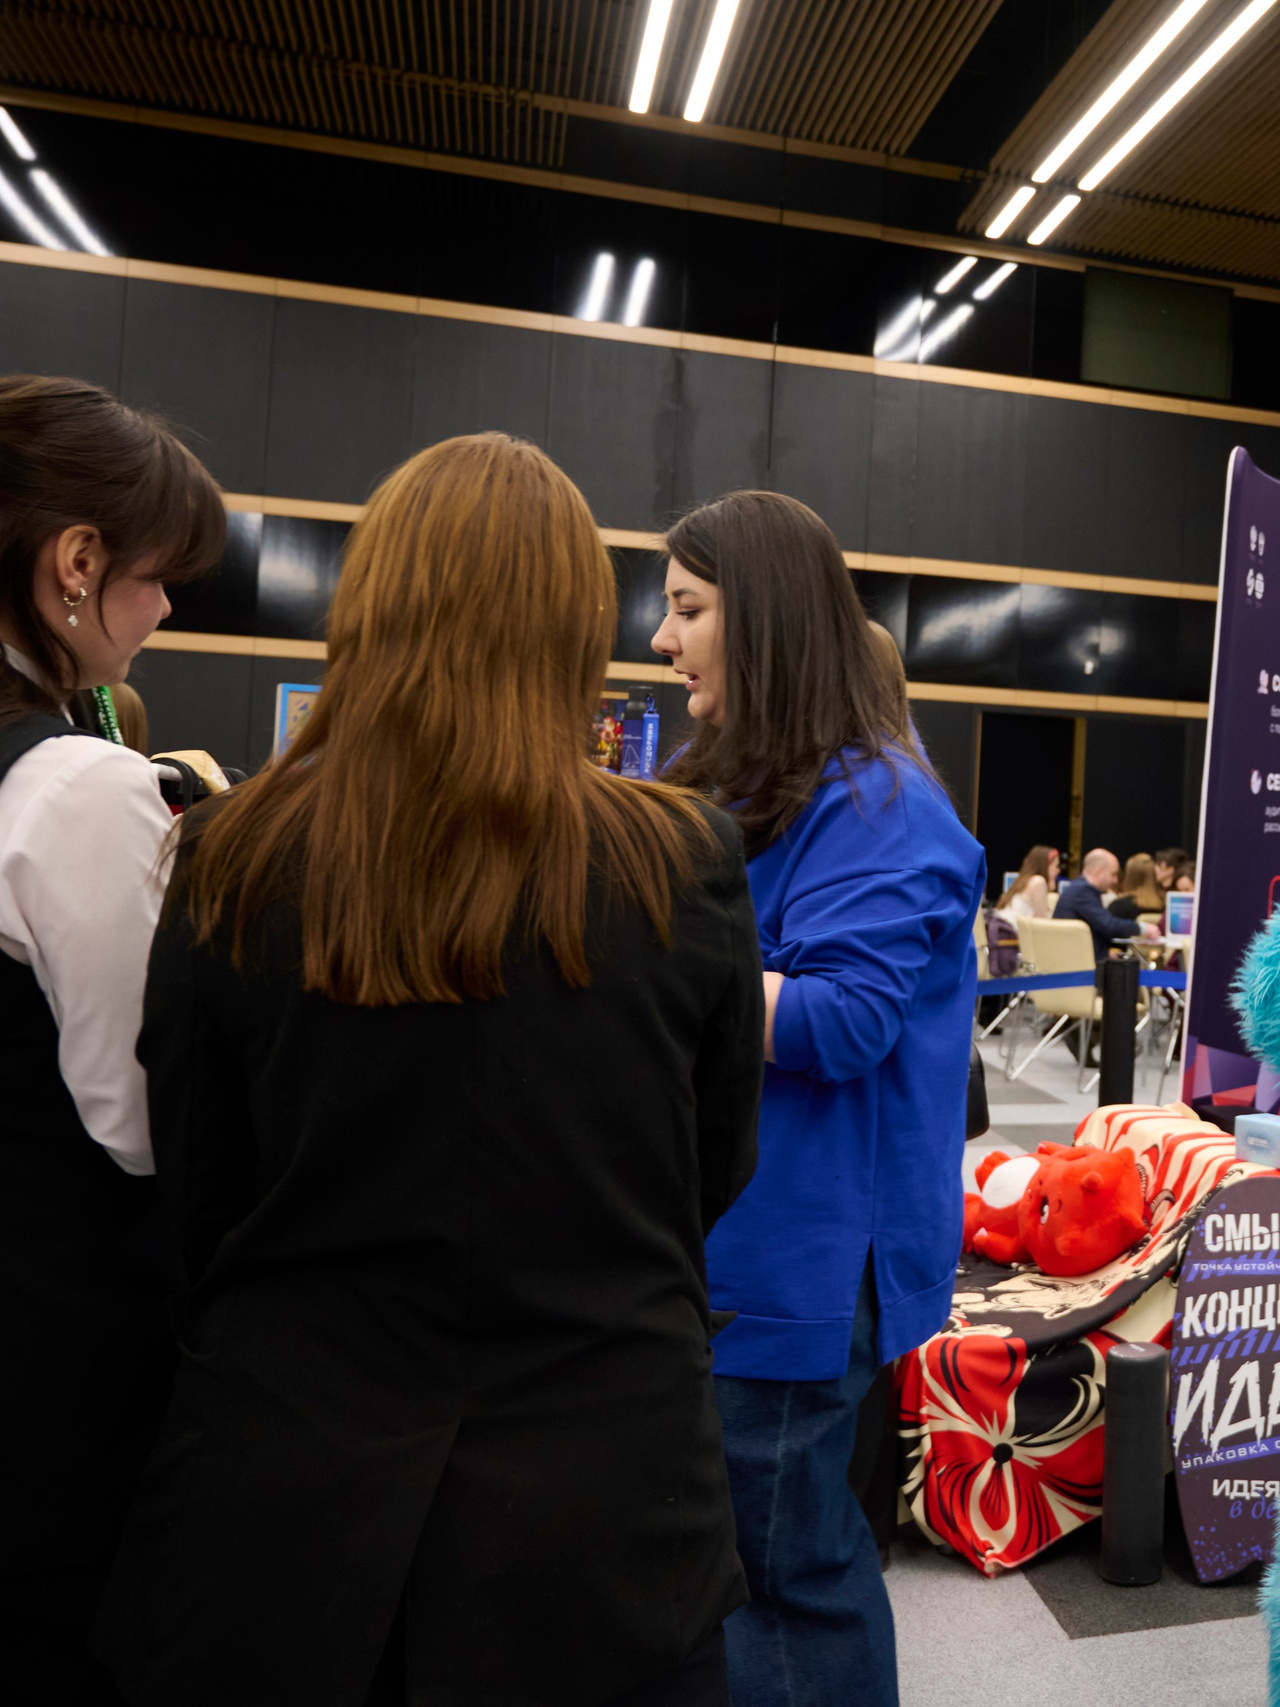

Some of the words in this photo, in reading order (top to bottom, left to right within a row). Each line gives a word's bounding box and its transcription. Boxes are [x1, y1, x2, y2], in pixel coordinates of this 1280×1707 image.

[1193, 1262, 1232, 1271] ТОЧКА
[1181, 1444, 1269, 1468] УПАКОВКА
[1212, 1478, 1280, 1500] ИДЕЯ
[1230, 1500, 1243, 1519] в
